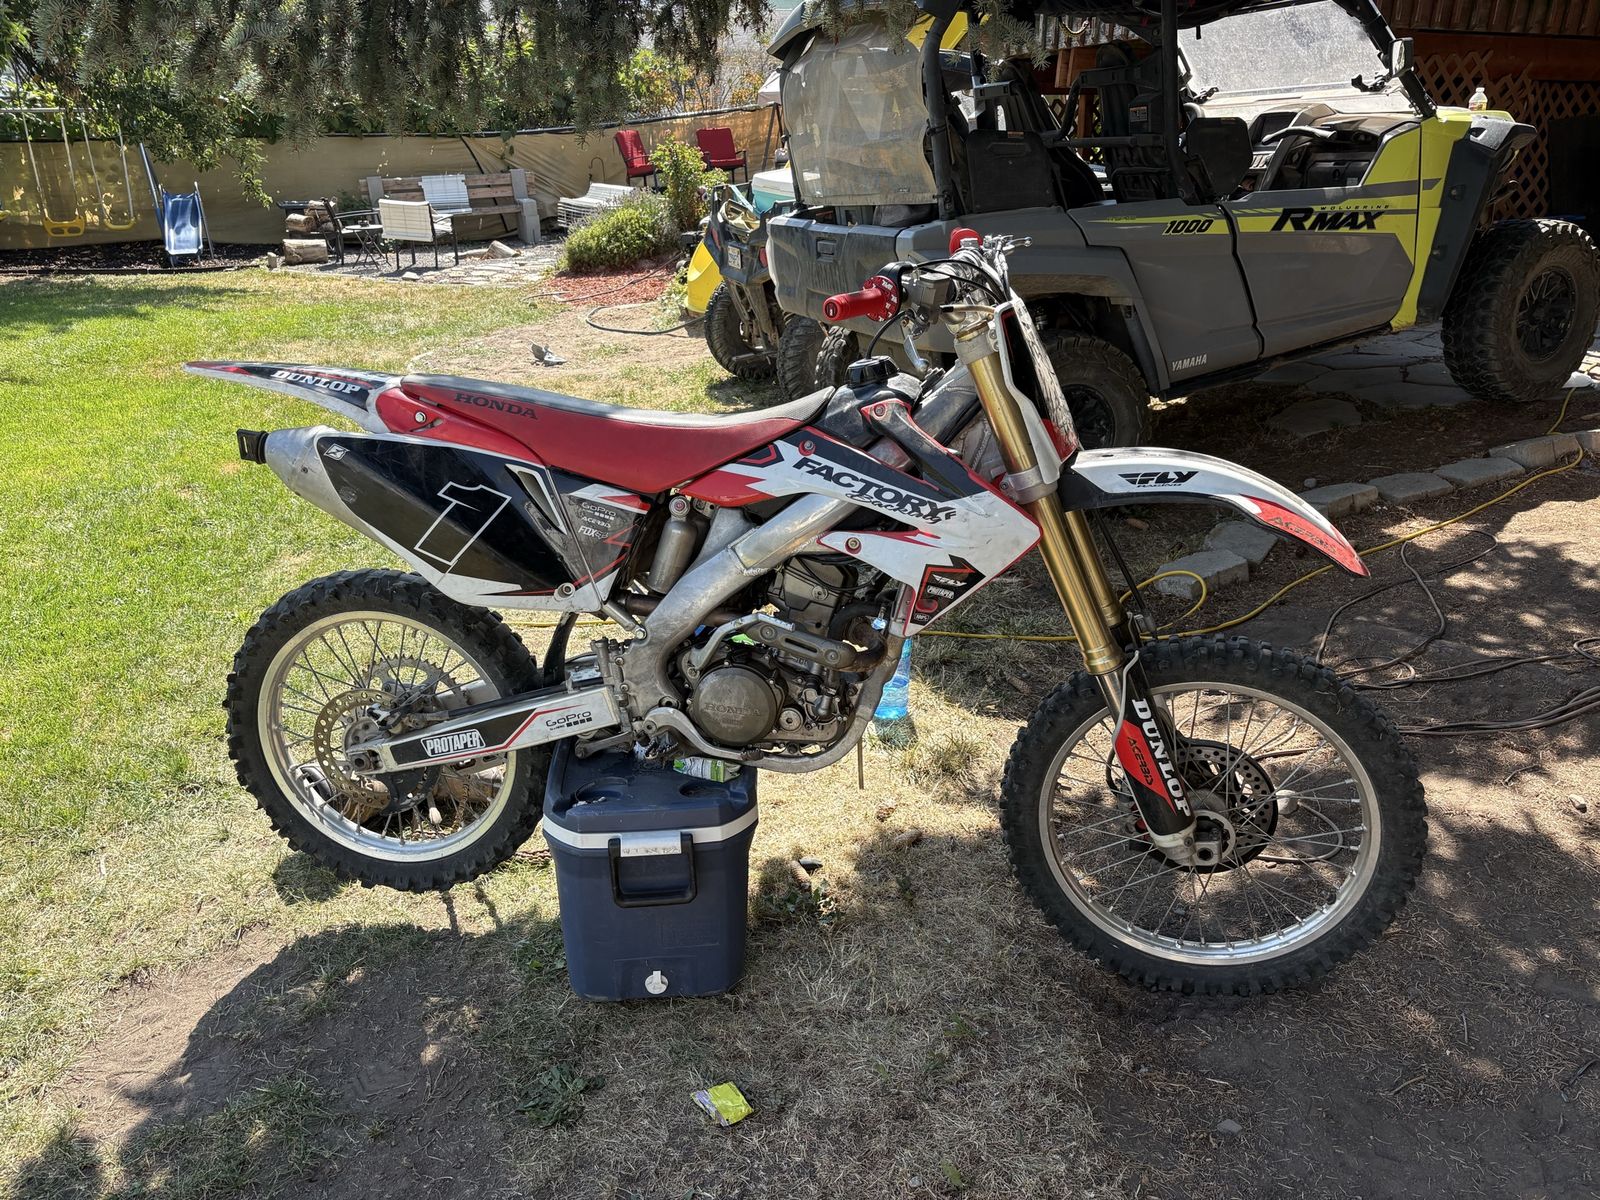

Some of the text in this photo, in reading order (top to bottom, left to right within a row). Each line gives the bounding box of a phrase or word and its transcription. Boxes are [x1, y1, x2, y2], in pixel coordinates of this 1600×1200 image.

[1162, 218, 1214, 235] 1000
[1269, 207, 1385, 232] RMAX
[1172, 353, 1208, 372] YAMAHA
[270, 369, 361, 394] DUNLOP
[454, 392, 539, 421] HONDA
[792, 456, 957, 517] FACTORY
[581, 501, 617, 517] GoPro
[545, 711, 592, 727] GoPro
[425, 731, 482, 756] PROTAPER
[1131, 697, 1192, 817] DUNLOP
